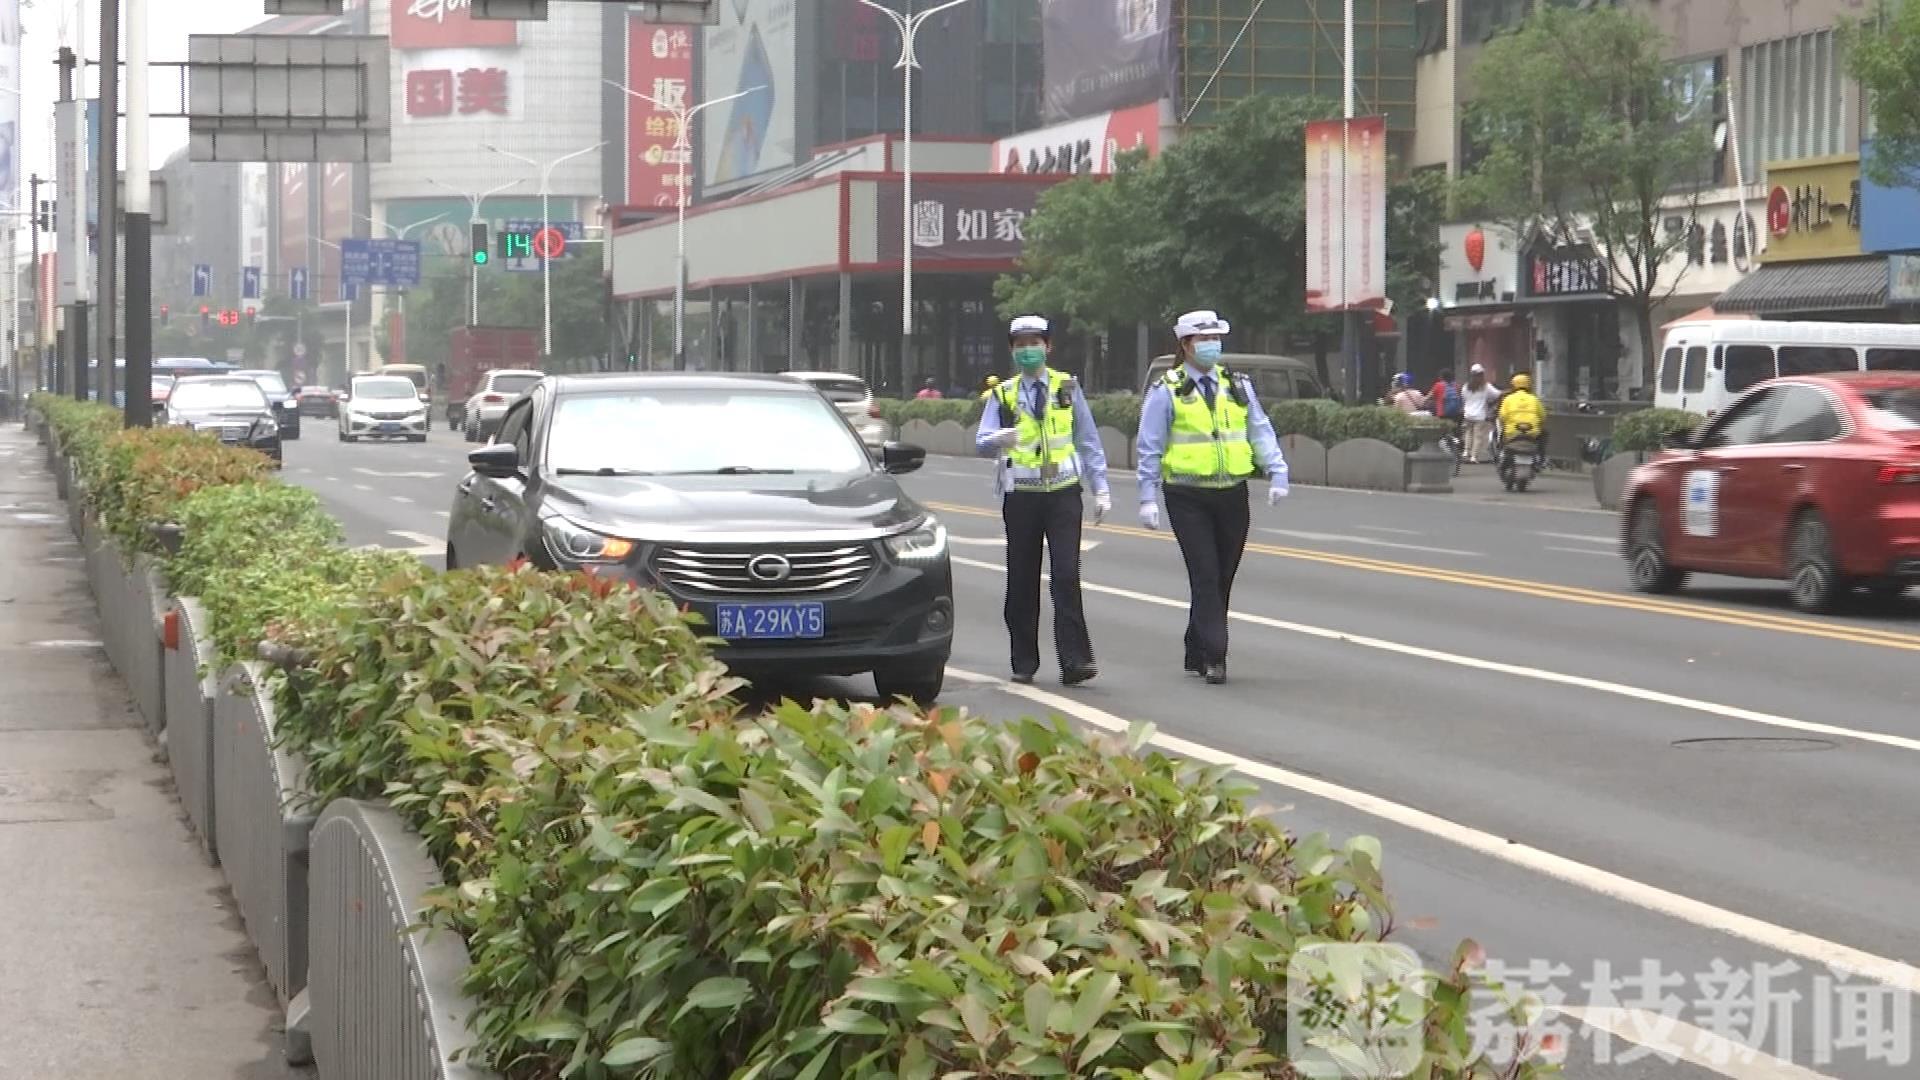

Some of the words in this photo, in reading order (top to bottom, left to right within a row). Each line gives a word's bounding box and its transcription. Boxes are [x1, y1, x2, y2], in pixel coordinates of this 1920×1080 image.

[406, 68, 510, 118] 国美
[956, 208, 1036, 241] 如家
[507, 233, 530, 257] 14
[218, 309, 239, 326] 63
